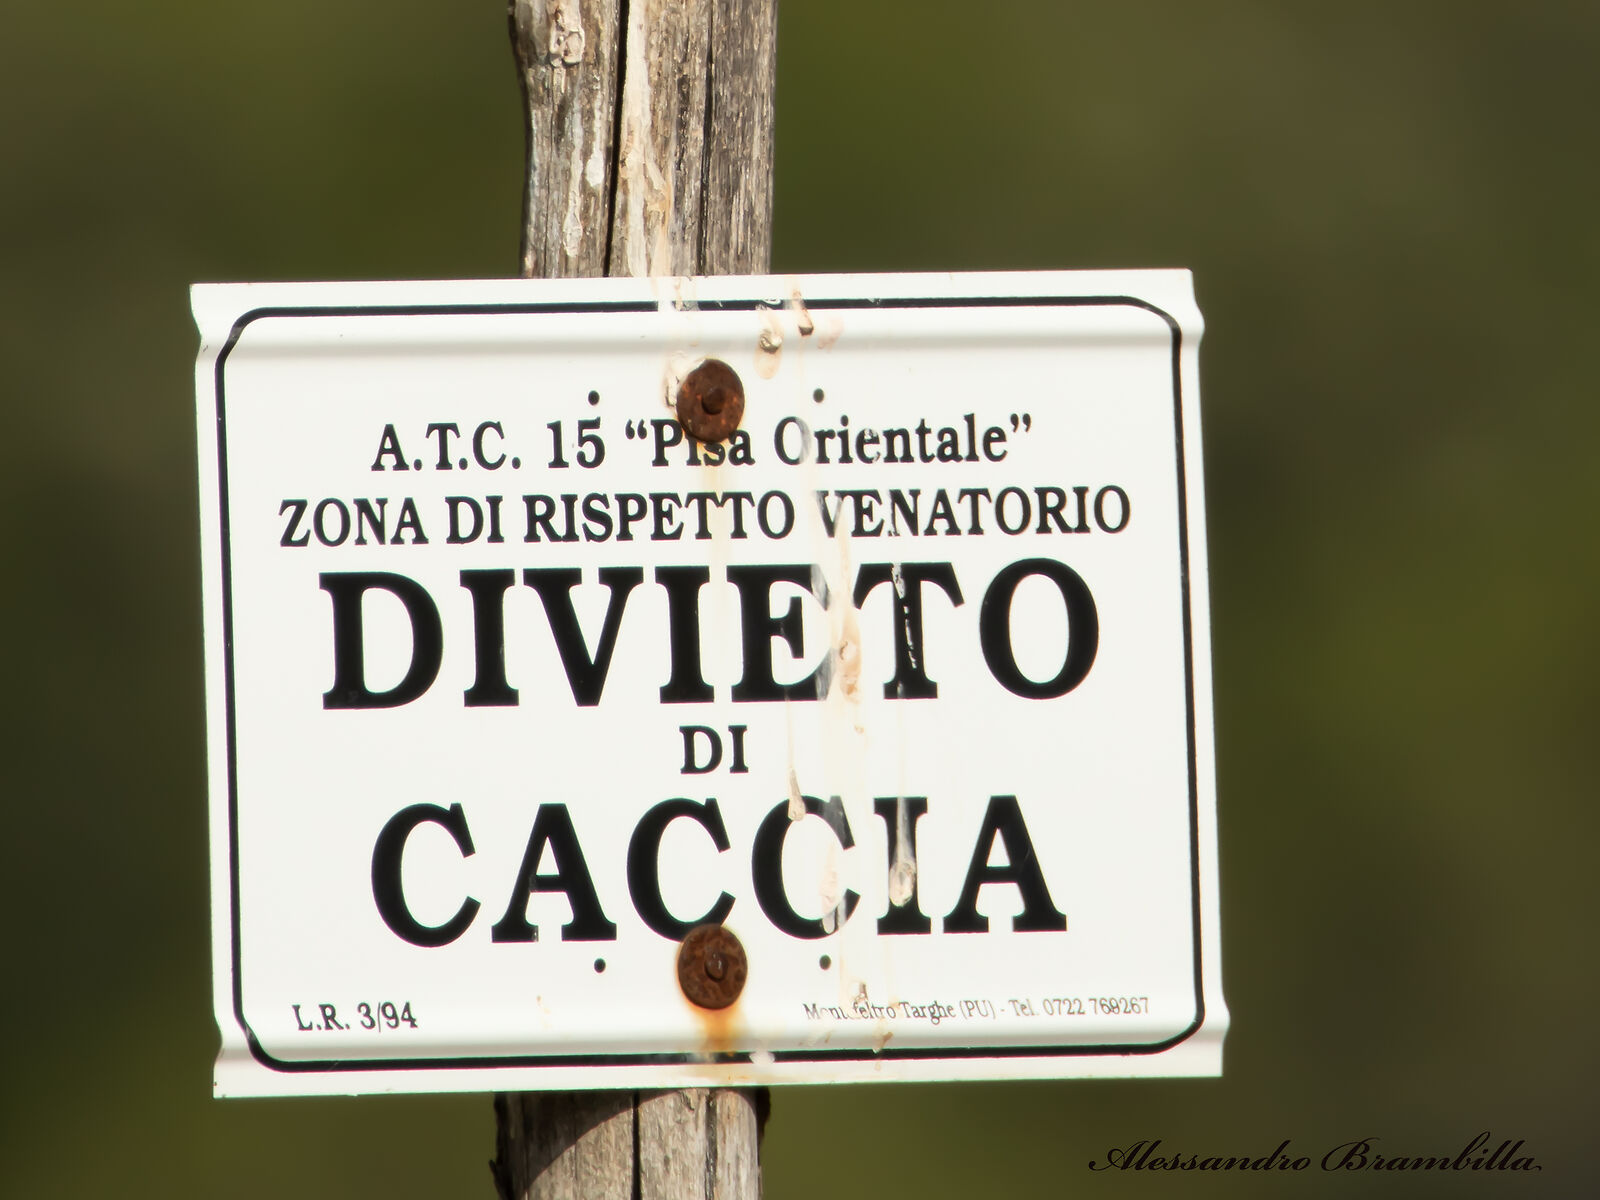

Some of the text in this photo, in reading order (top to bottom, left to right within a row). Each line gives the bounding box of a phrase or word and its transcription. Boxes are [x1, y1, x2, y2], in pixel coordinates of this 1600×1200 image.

[372, 422, 520, 471] A.T.C.
[547, 417, 605, 469] 15
[774, 413, 1031, 465] Orientale”
[279, 485, 1131, 548] ZONA DI RISPETTO VENATORIO
[319, 557, 1099, 710] DIVIETO
[679, 725, 749, 775] DI
[371, 795, 1067, 948] CACCIA
[291, 1001, 418, 1033] L.R. 3/94
[898, 1001, 956, 1025] Targhe
[959, 999, 996, 1020] (PU)
[1042, 998, 1086, 1016] 0722
